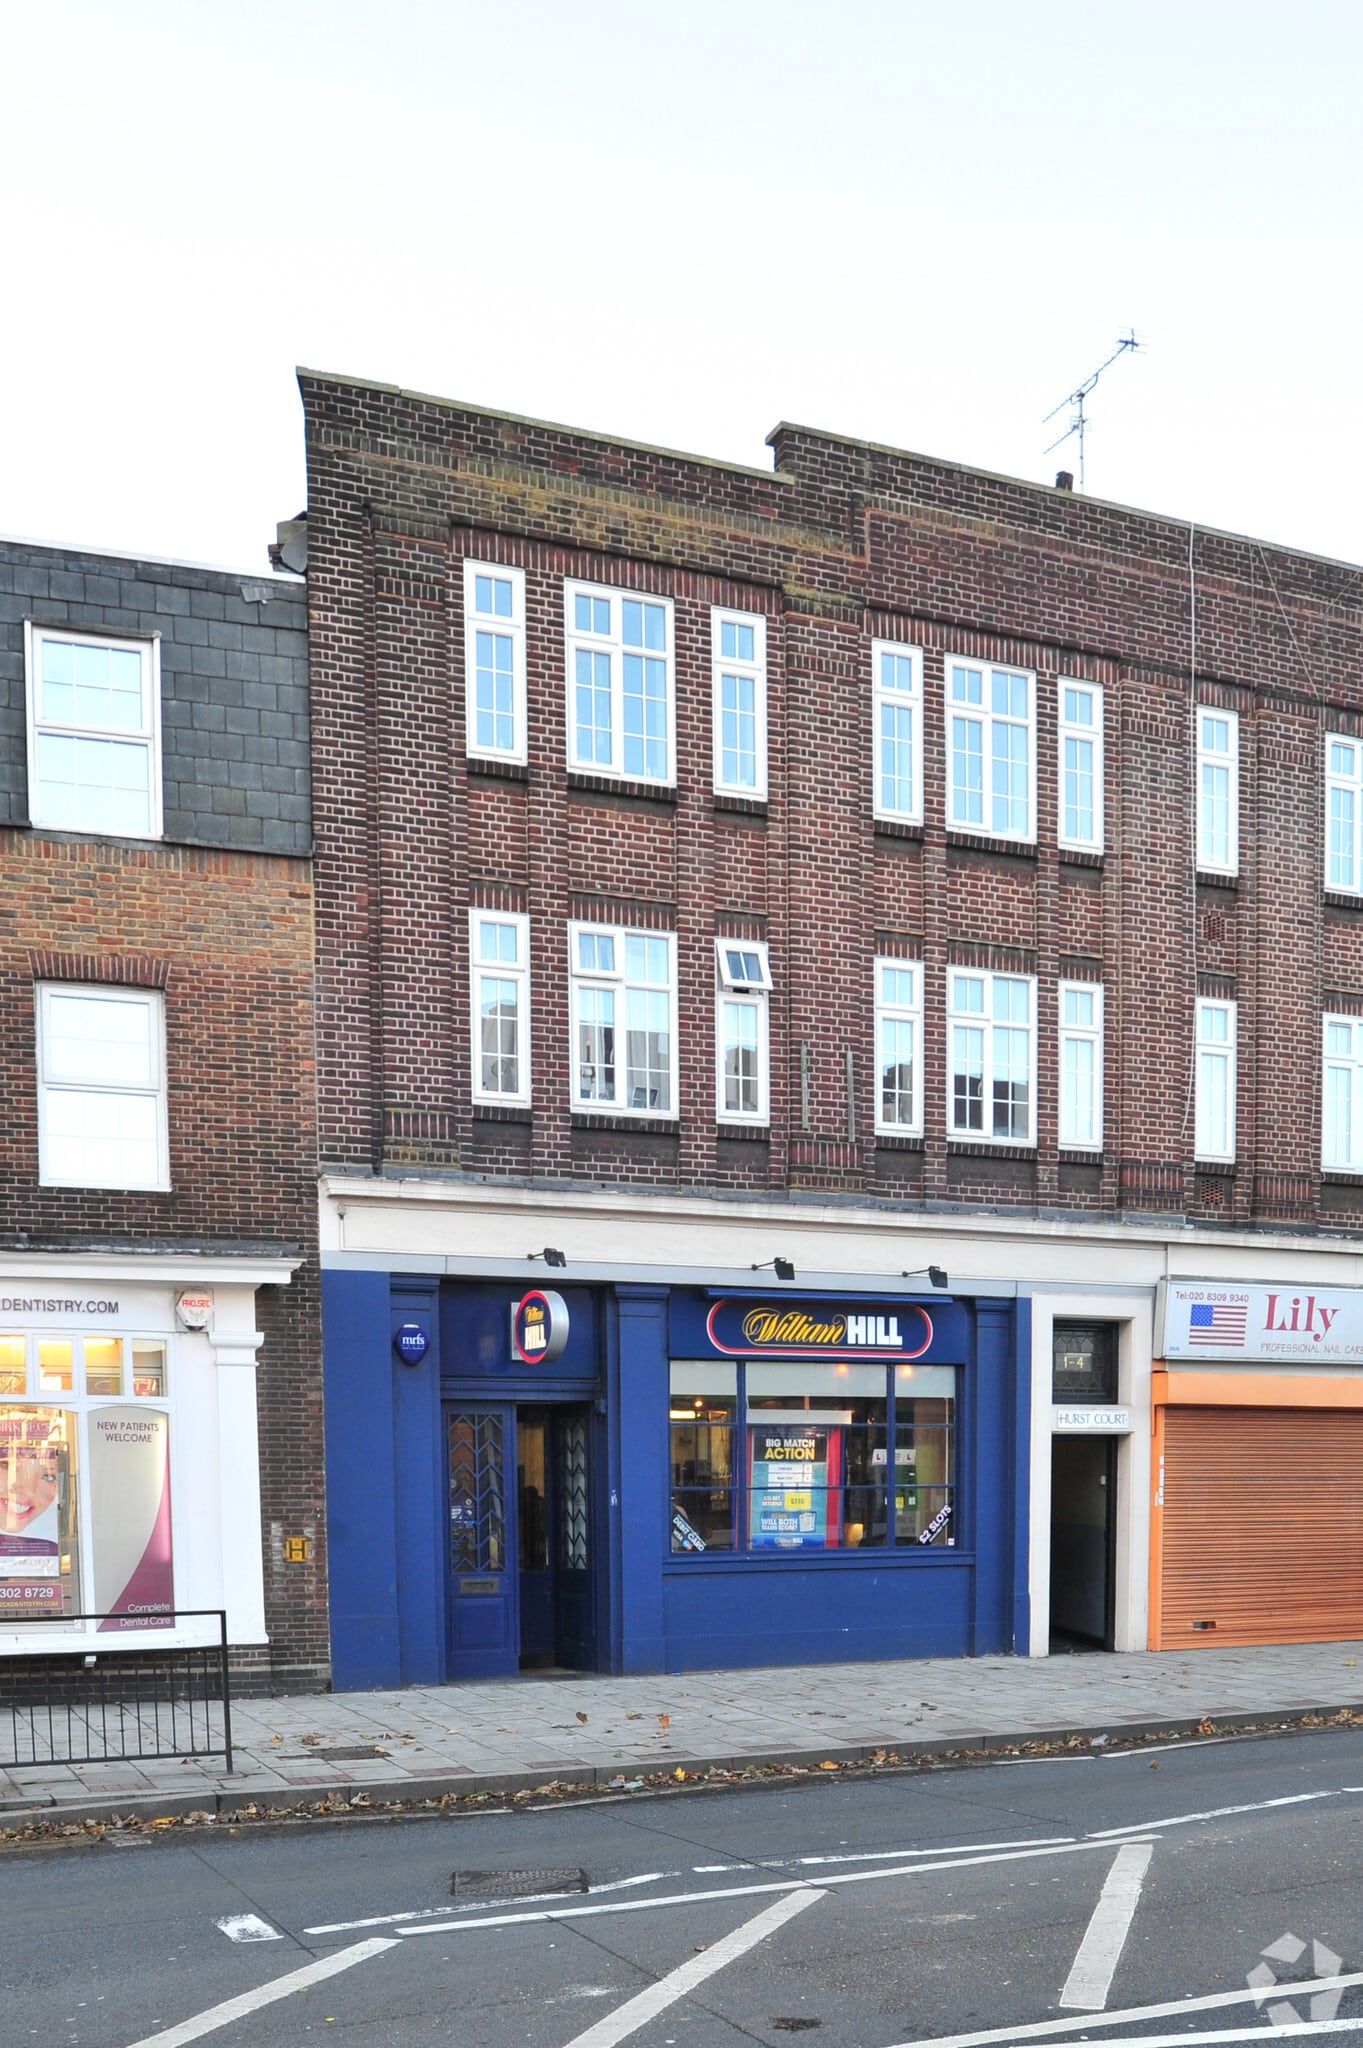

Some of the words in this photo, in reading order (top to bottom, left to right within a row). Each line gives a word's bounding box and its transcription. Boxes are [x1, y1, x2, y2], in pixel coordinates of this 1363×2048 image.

[1206, 1292, 1228, 1302] 8309
[1262, 1294, 1341, 1342] Lily
[742, 1307, 848, 1347] William
[847, 1315, 903, 1346] HILL
[524, 1324, 547, 1351] HILL
[1259, 1342, 1320, 1354] PROFESSIONAL
[1323, 1344, 1341, 1354] NAIL
[1059, 1413, 1090, 1425] HURST
[1093, 1413, 1127, 1425] COURT
[96, 1421, 118, 1431] NEW
[120, 1421, 159, 1432] PATIENTS
[105, 1433, 152, 1443] WELCOME
[765, 1438, 781, 1448] BIG
[783, 1438, 816, 1449] MATCH
[764, 1447, 816, 1460] ACTION
[929, 1504, 952, 1532] SLOTS
[672, 1516, 690, 1536] DEBIT
[687, 1533, 705, 1552] CARD
[24, 1587, 54, 1598] 8729
[127, 1602, 170, 1613] Complete
[120, 1616, 148, 1627] Dental
[149, 1616, 171, 1626] Care
